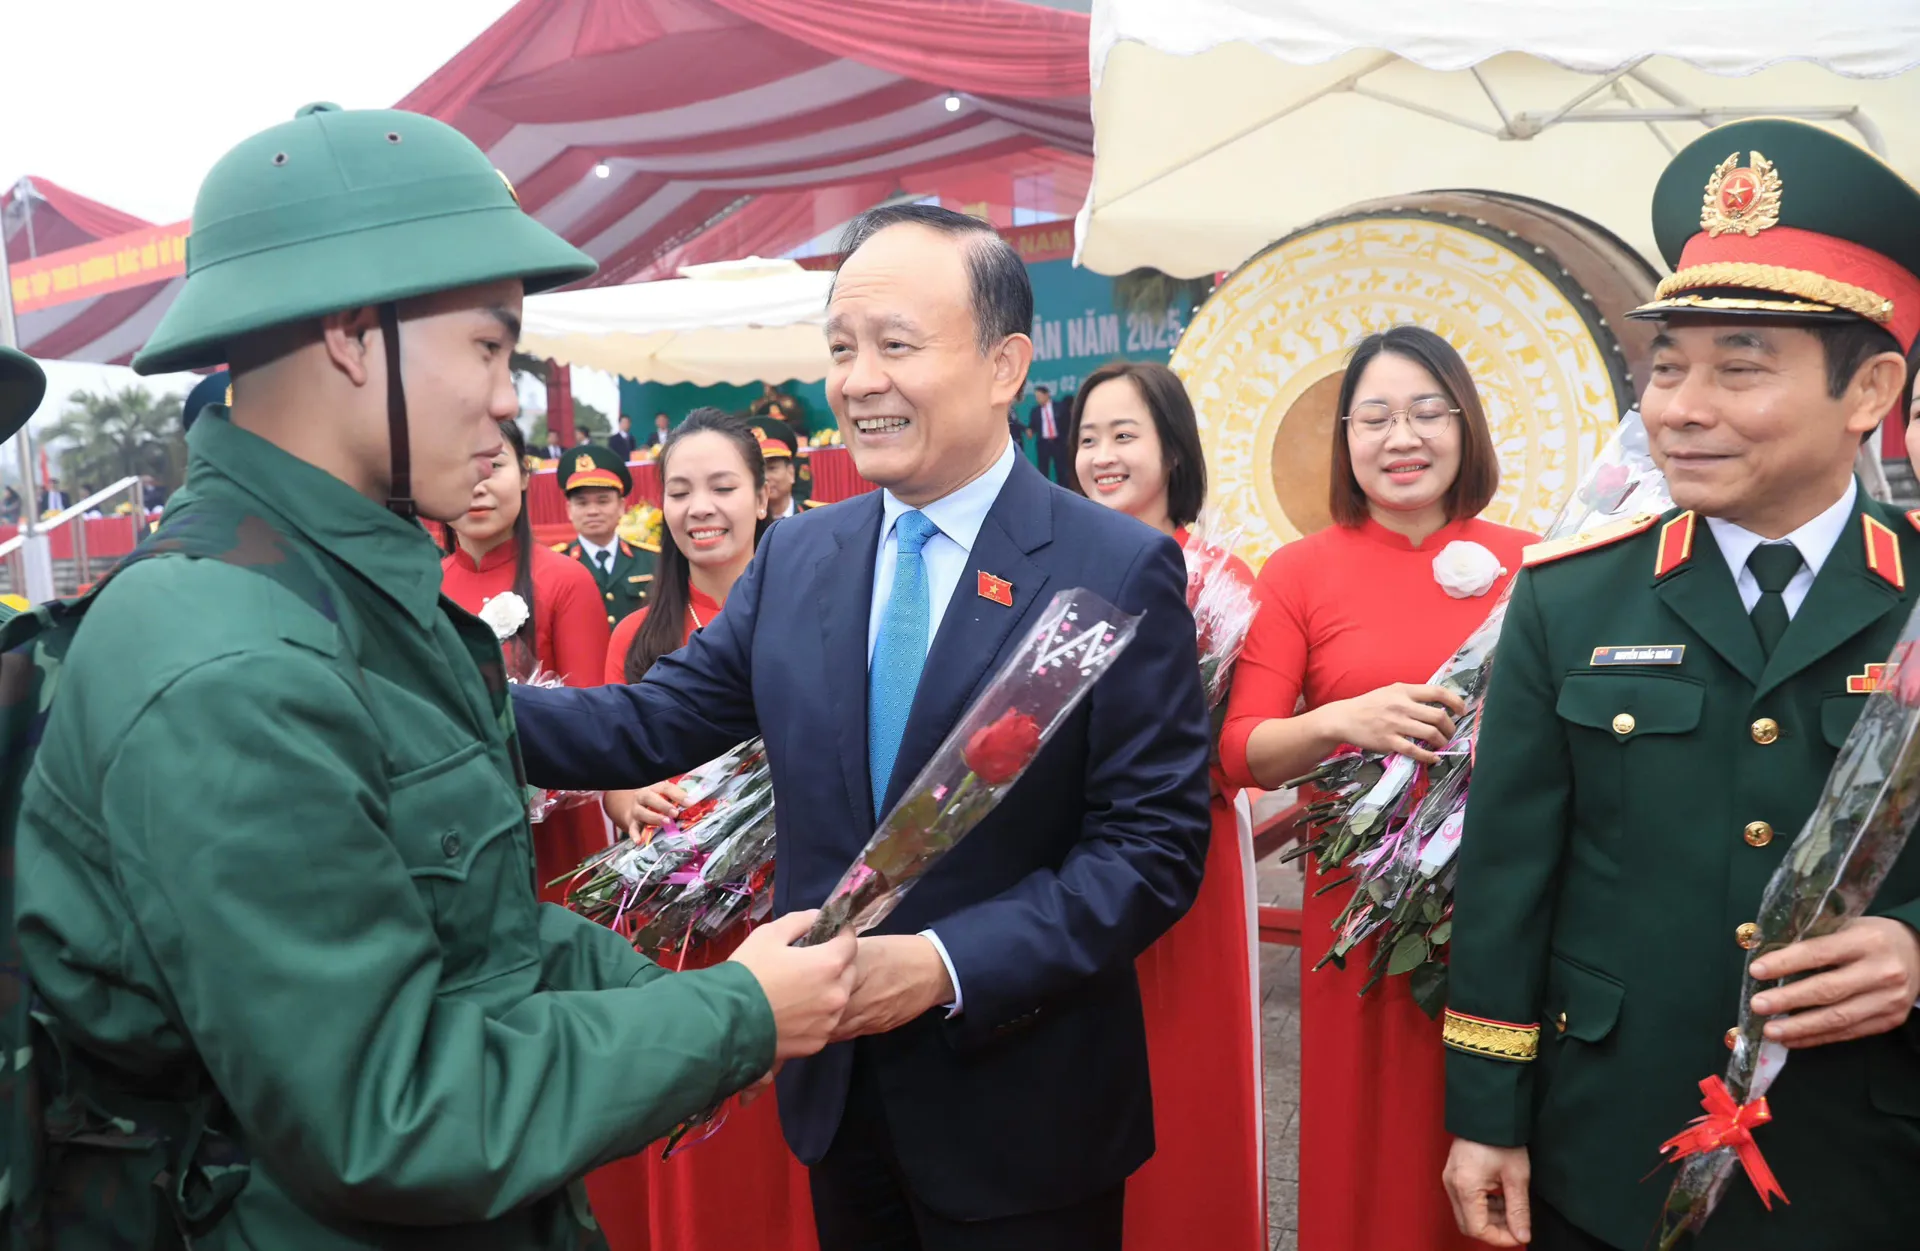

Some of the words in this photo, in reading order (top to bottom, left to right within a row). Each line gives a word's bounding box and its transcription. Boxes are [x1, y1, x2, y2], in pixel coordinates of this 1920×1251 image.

[1020, 229, 1070, 253] NAM
[1032, 315, 1062, 361] ÂN
[1067, 309, 1120, 357] NĂM
[1126, 308, 1181, 351] 2025
[1060, 375, 1076, 392] 02
